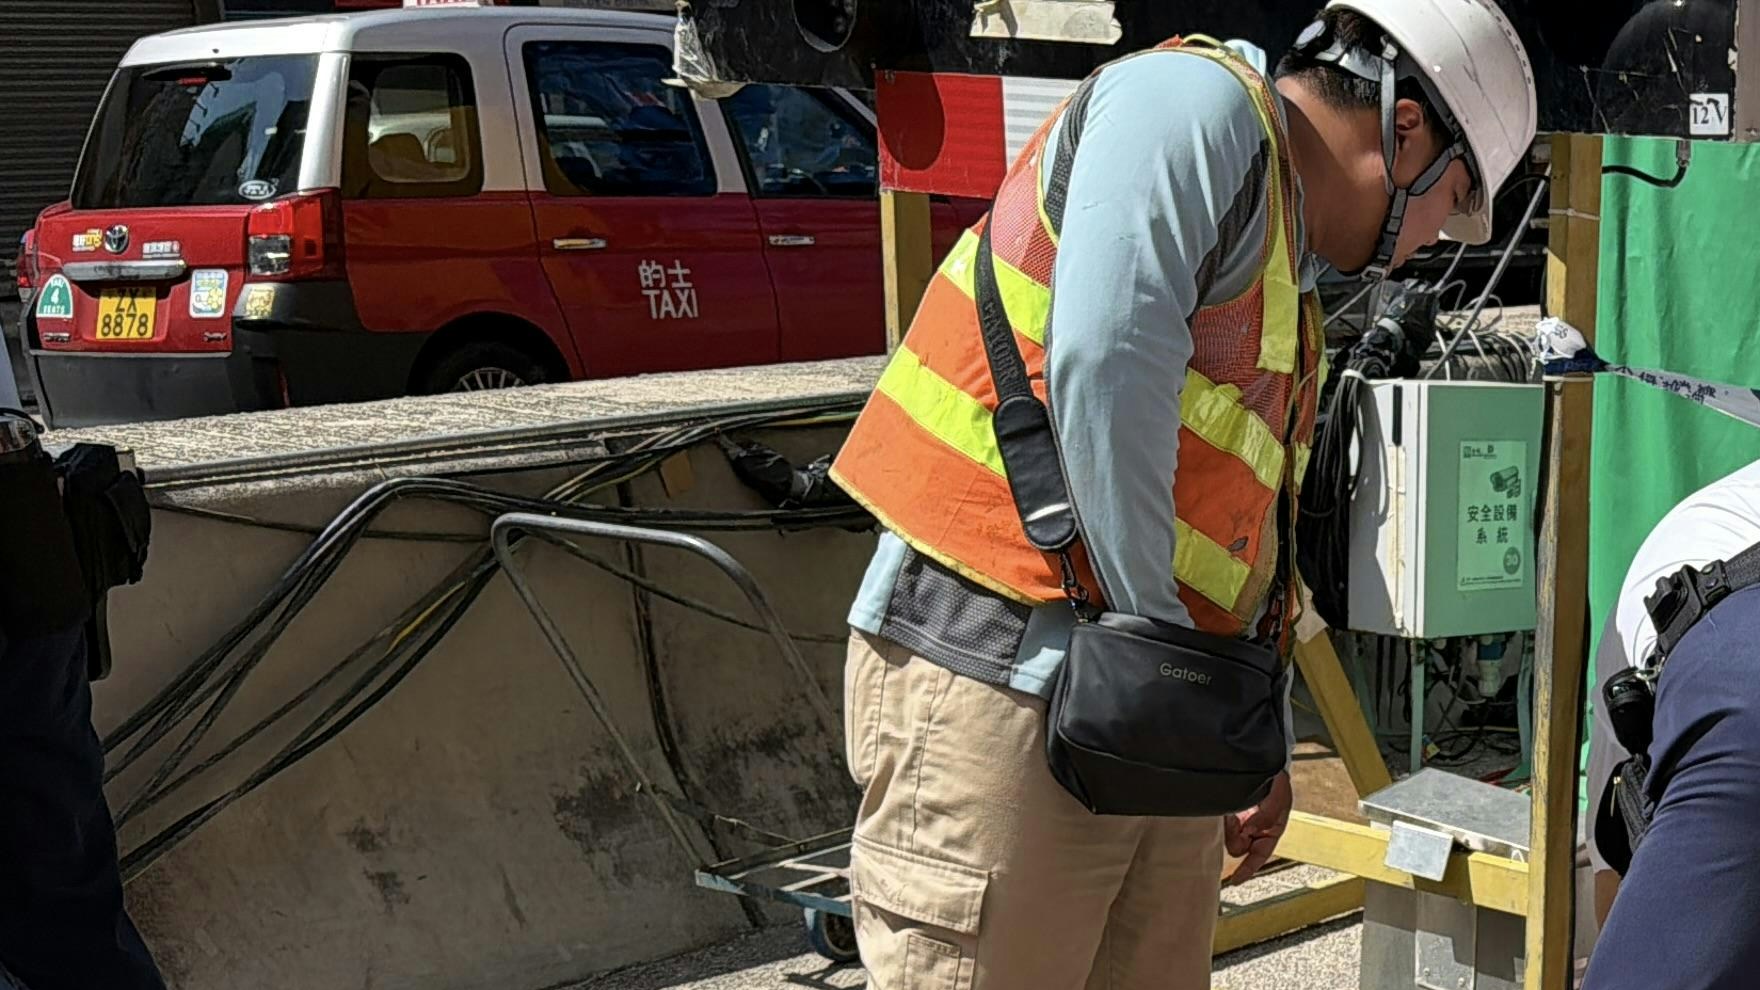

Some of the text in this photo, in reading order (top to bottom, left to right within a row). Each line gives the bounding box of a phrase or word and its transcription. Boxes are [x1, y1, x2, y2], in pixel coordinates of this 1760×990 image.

[638, 259, 693, 288] 的士
[51, 289, 60, 304] 4
[641, 289, 699, 319] TAXI
[101, 313, 149, 337] 8878
[1467, 504, 1517, 522] 安全設備
[1160, 662, 1212, 685] Gatoer
